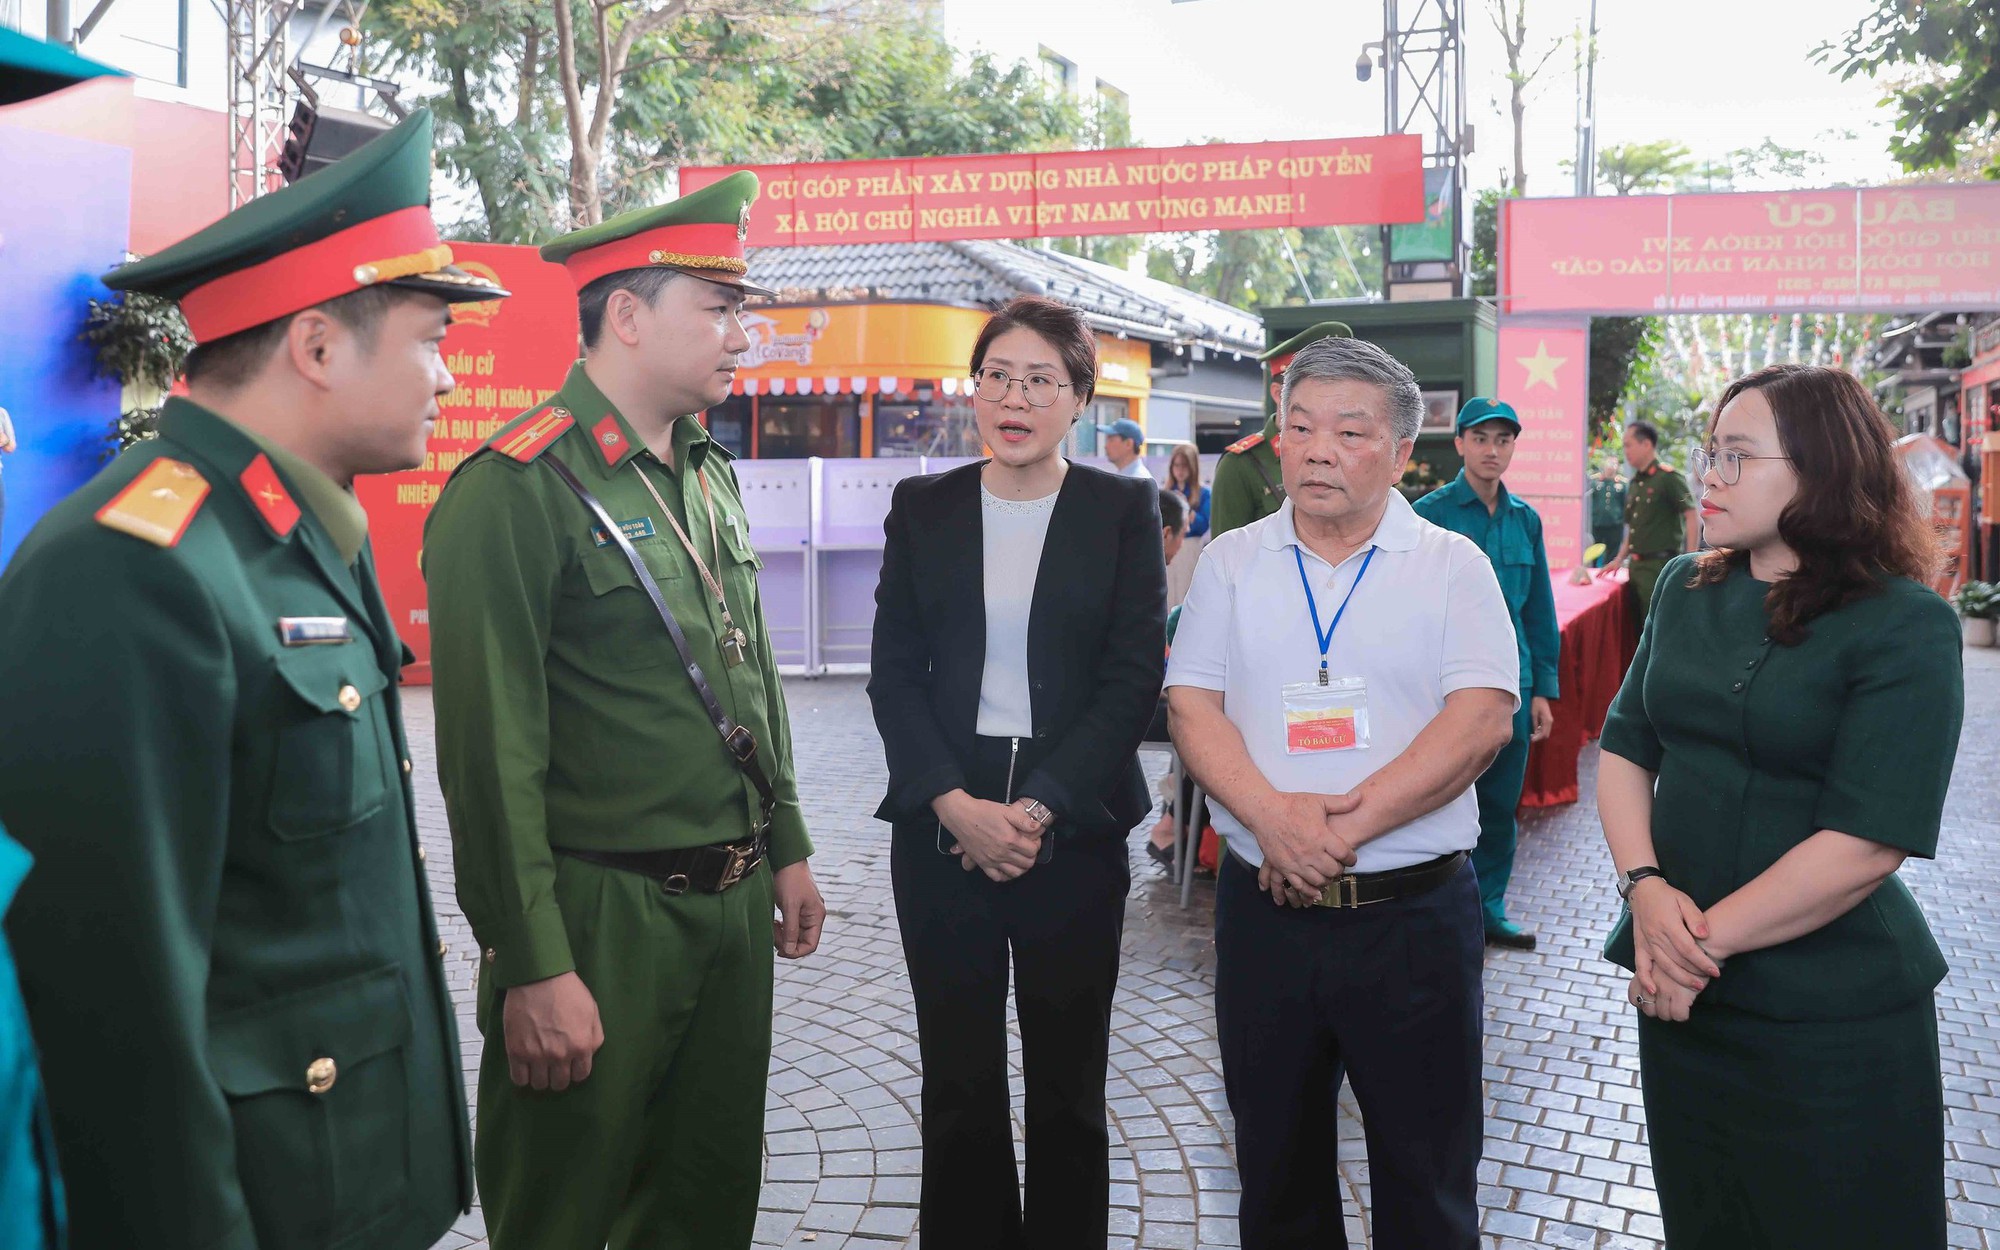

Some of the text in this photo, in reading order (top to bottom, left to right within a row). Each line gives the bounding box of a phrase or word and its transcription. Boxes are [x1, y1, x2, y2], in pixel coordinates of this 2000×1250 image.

[767, 146, 1373, 200] CỬ GÓP PHẦN XÂY DỰNG NHÀ NƯỚC PHÁP QUYỀN
[775, 210, 810, 233] XÃ
[815, 208, 859, 236] HỘI
[864, 204, 913, 231] CHỦ
[919, 203, 1001, 229] NGHĨA
[1006, 200, 1067, 228] VIỆT
[1071, 201, 1131, 224] NAM
[1136, 195, 1208, 221] VỮNG
[1214, 193, 1294, 220] MẠNH
[476, 349, 495, 376] CỬ
[476, 384, 497, 412] HỘI
[500, 384, 533, 409] KHÓA
[451, 419, 474, 444] ĐẠI
[438, 448, 471, 472] NHÂ
[397, 480, 440, 508] NHIỆM
